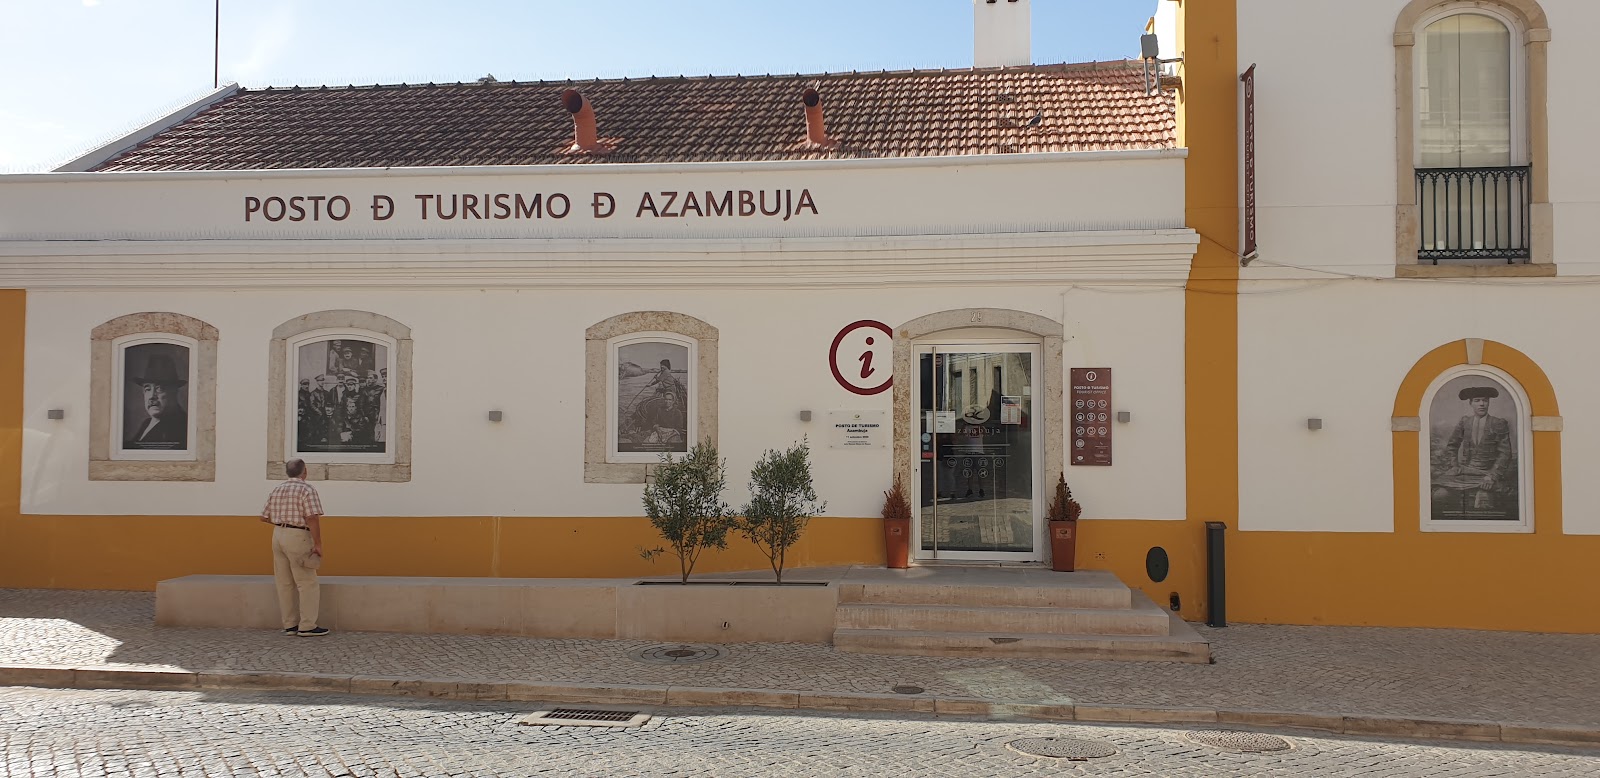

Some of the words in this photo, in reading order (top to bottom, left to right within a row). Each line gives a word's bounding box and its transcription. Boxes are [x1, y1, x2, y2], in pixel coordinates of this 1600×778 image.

[244, 196, 351, 222] POSTO
[414, 192, 571, 220] TURISMO
[636, 188, 819, 222] AZAMBUJA
